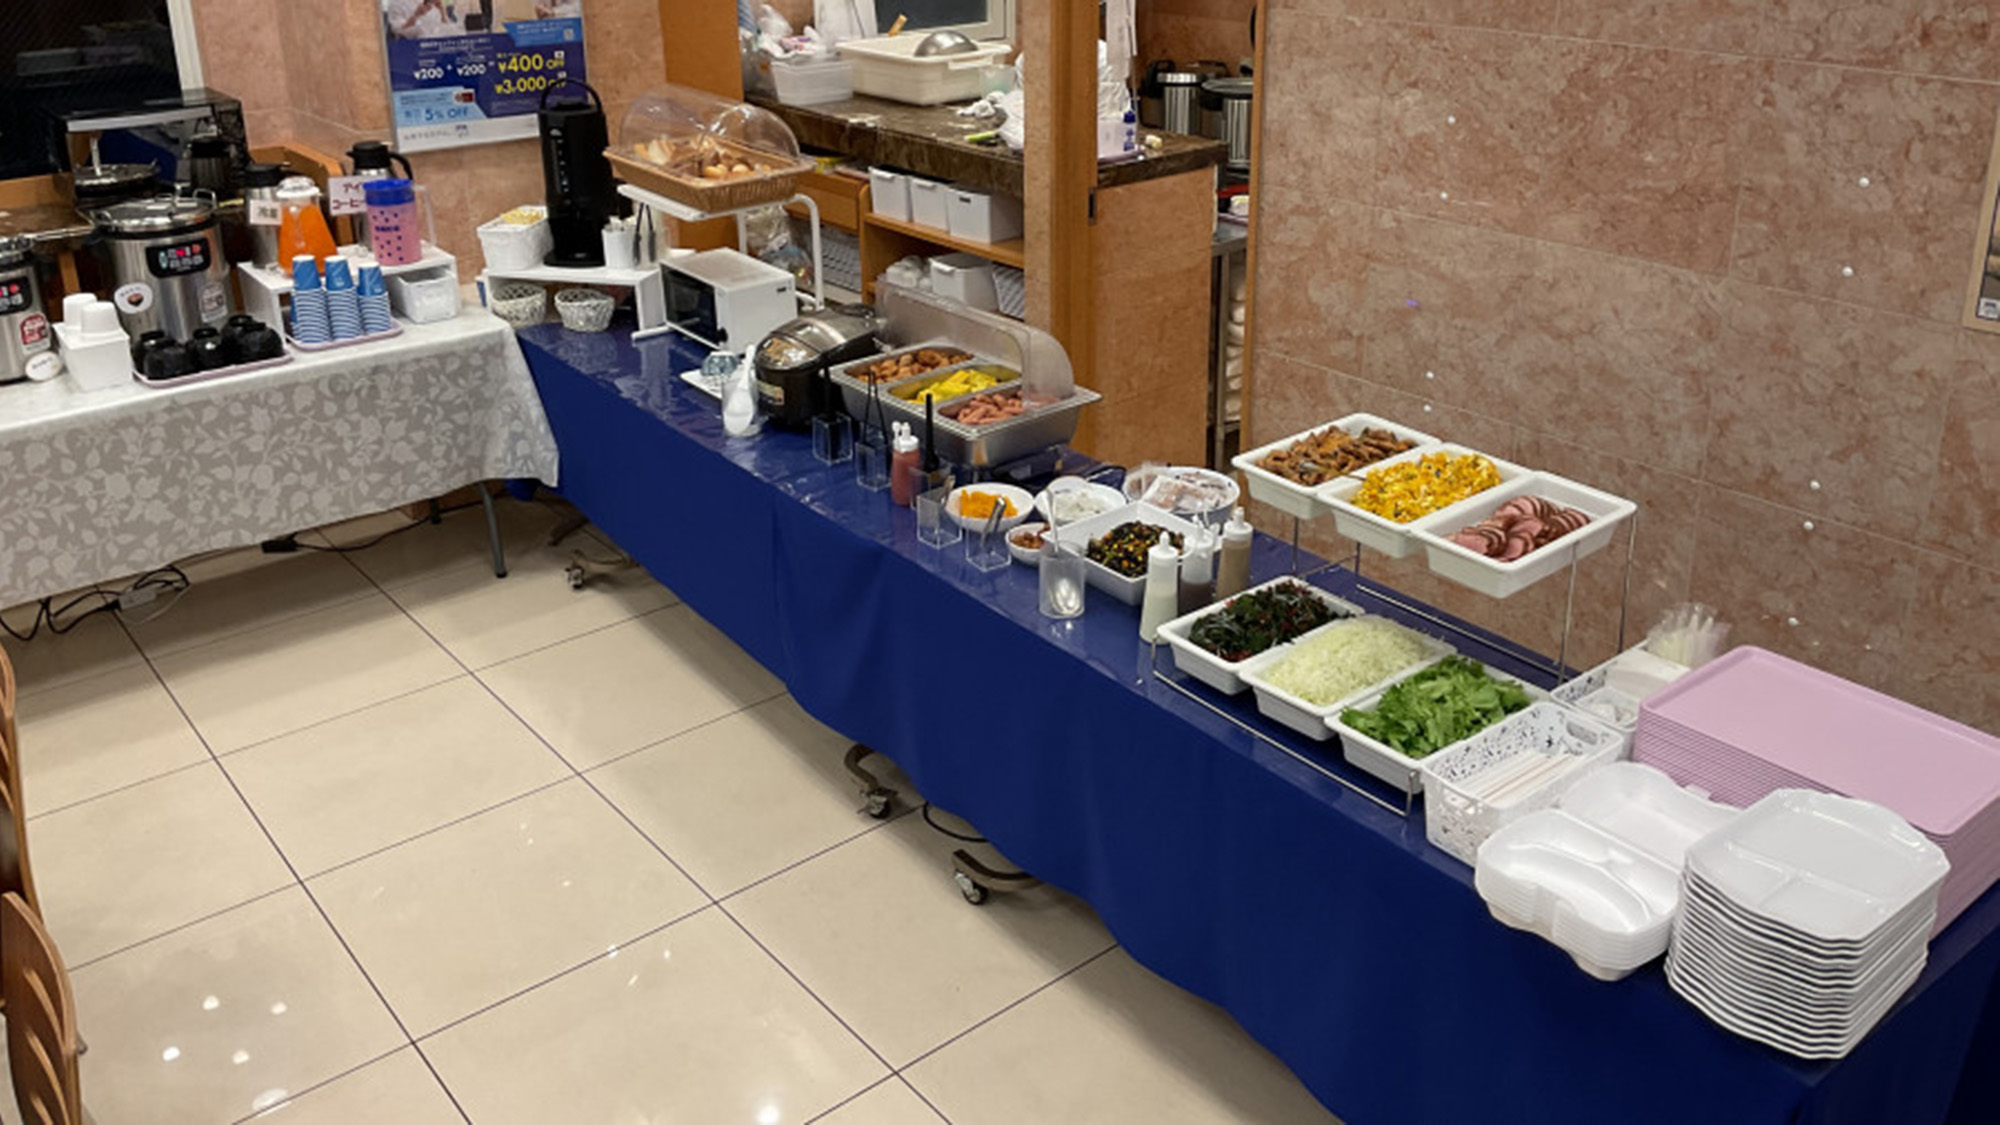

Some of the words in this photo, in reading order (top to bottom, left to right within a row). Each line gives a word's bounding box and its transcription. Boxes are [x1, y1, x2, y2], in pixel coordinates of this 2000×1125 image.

[413, 66, 444, 80] ¥200
[457, 64, 487, 77] ¥200
[498, 53, 544, 74] ¥400
[495, 75, 547, 94] ¥3,000
[343, 182, 362, 194] アイ
